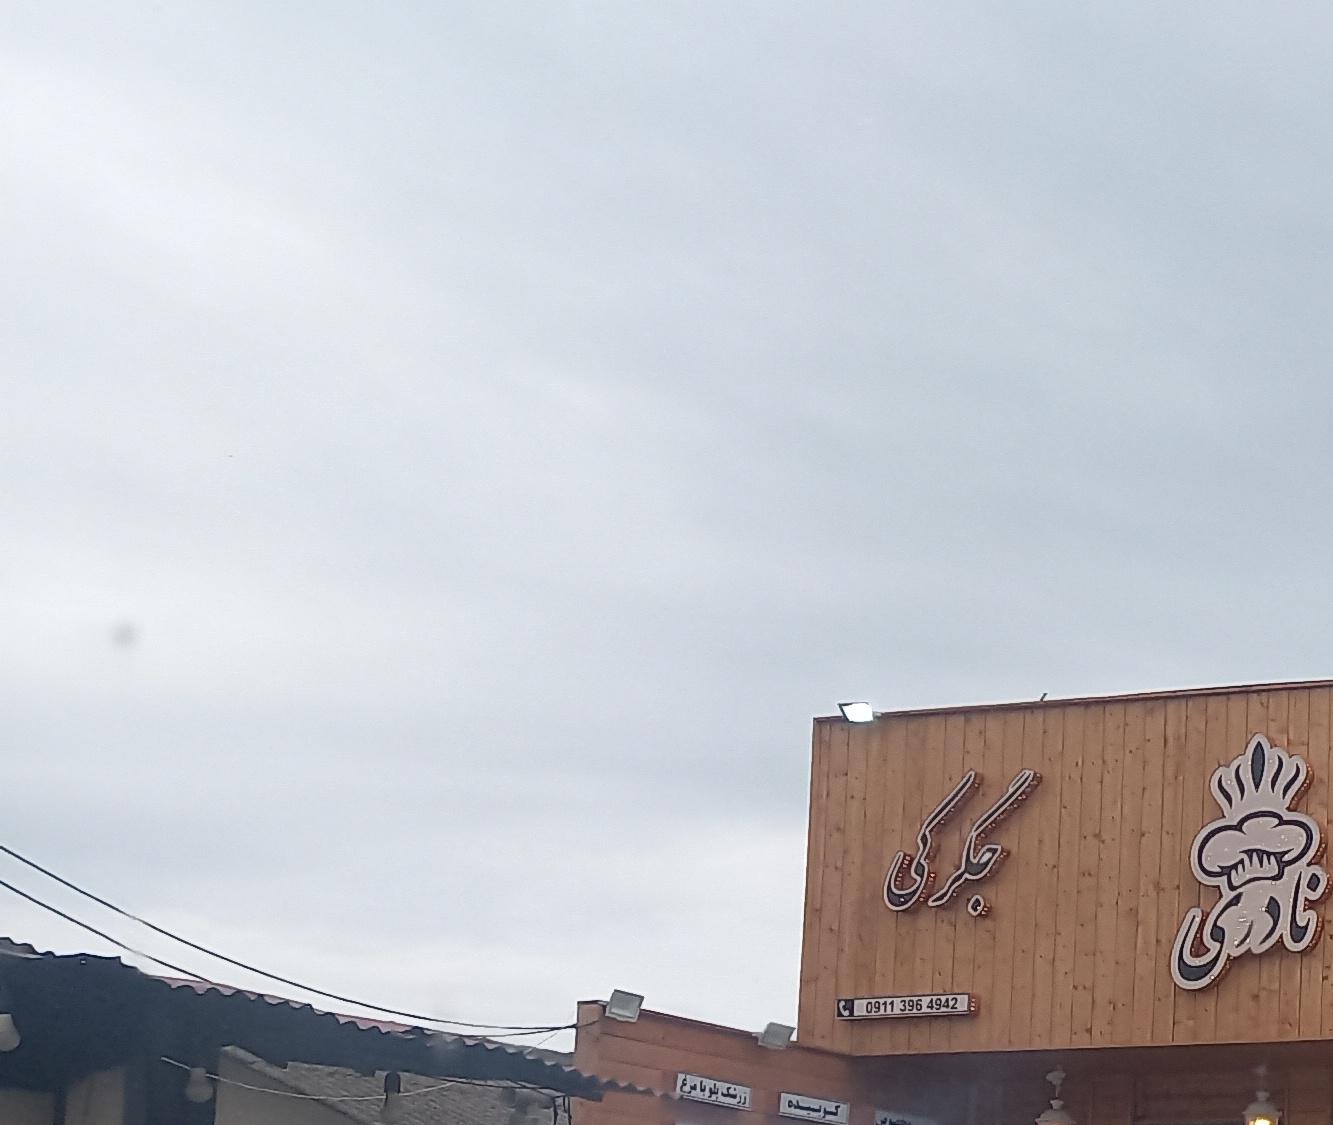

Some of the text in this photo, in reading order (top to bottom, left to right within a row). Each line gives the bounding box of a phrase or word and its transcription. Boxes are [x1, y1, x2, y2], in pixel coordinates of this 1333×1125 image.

[883, 767, 1041, 917] جگرکی
[1171, 865, 1330, 990] نادری
[866, 997, 958, 1014] 0911 396 4942
[679, 1074, 698, 1094] مرغ
[721, 1085, 747, 1106] زرشک
[788, 1099, 840, 1119] کوبیده
